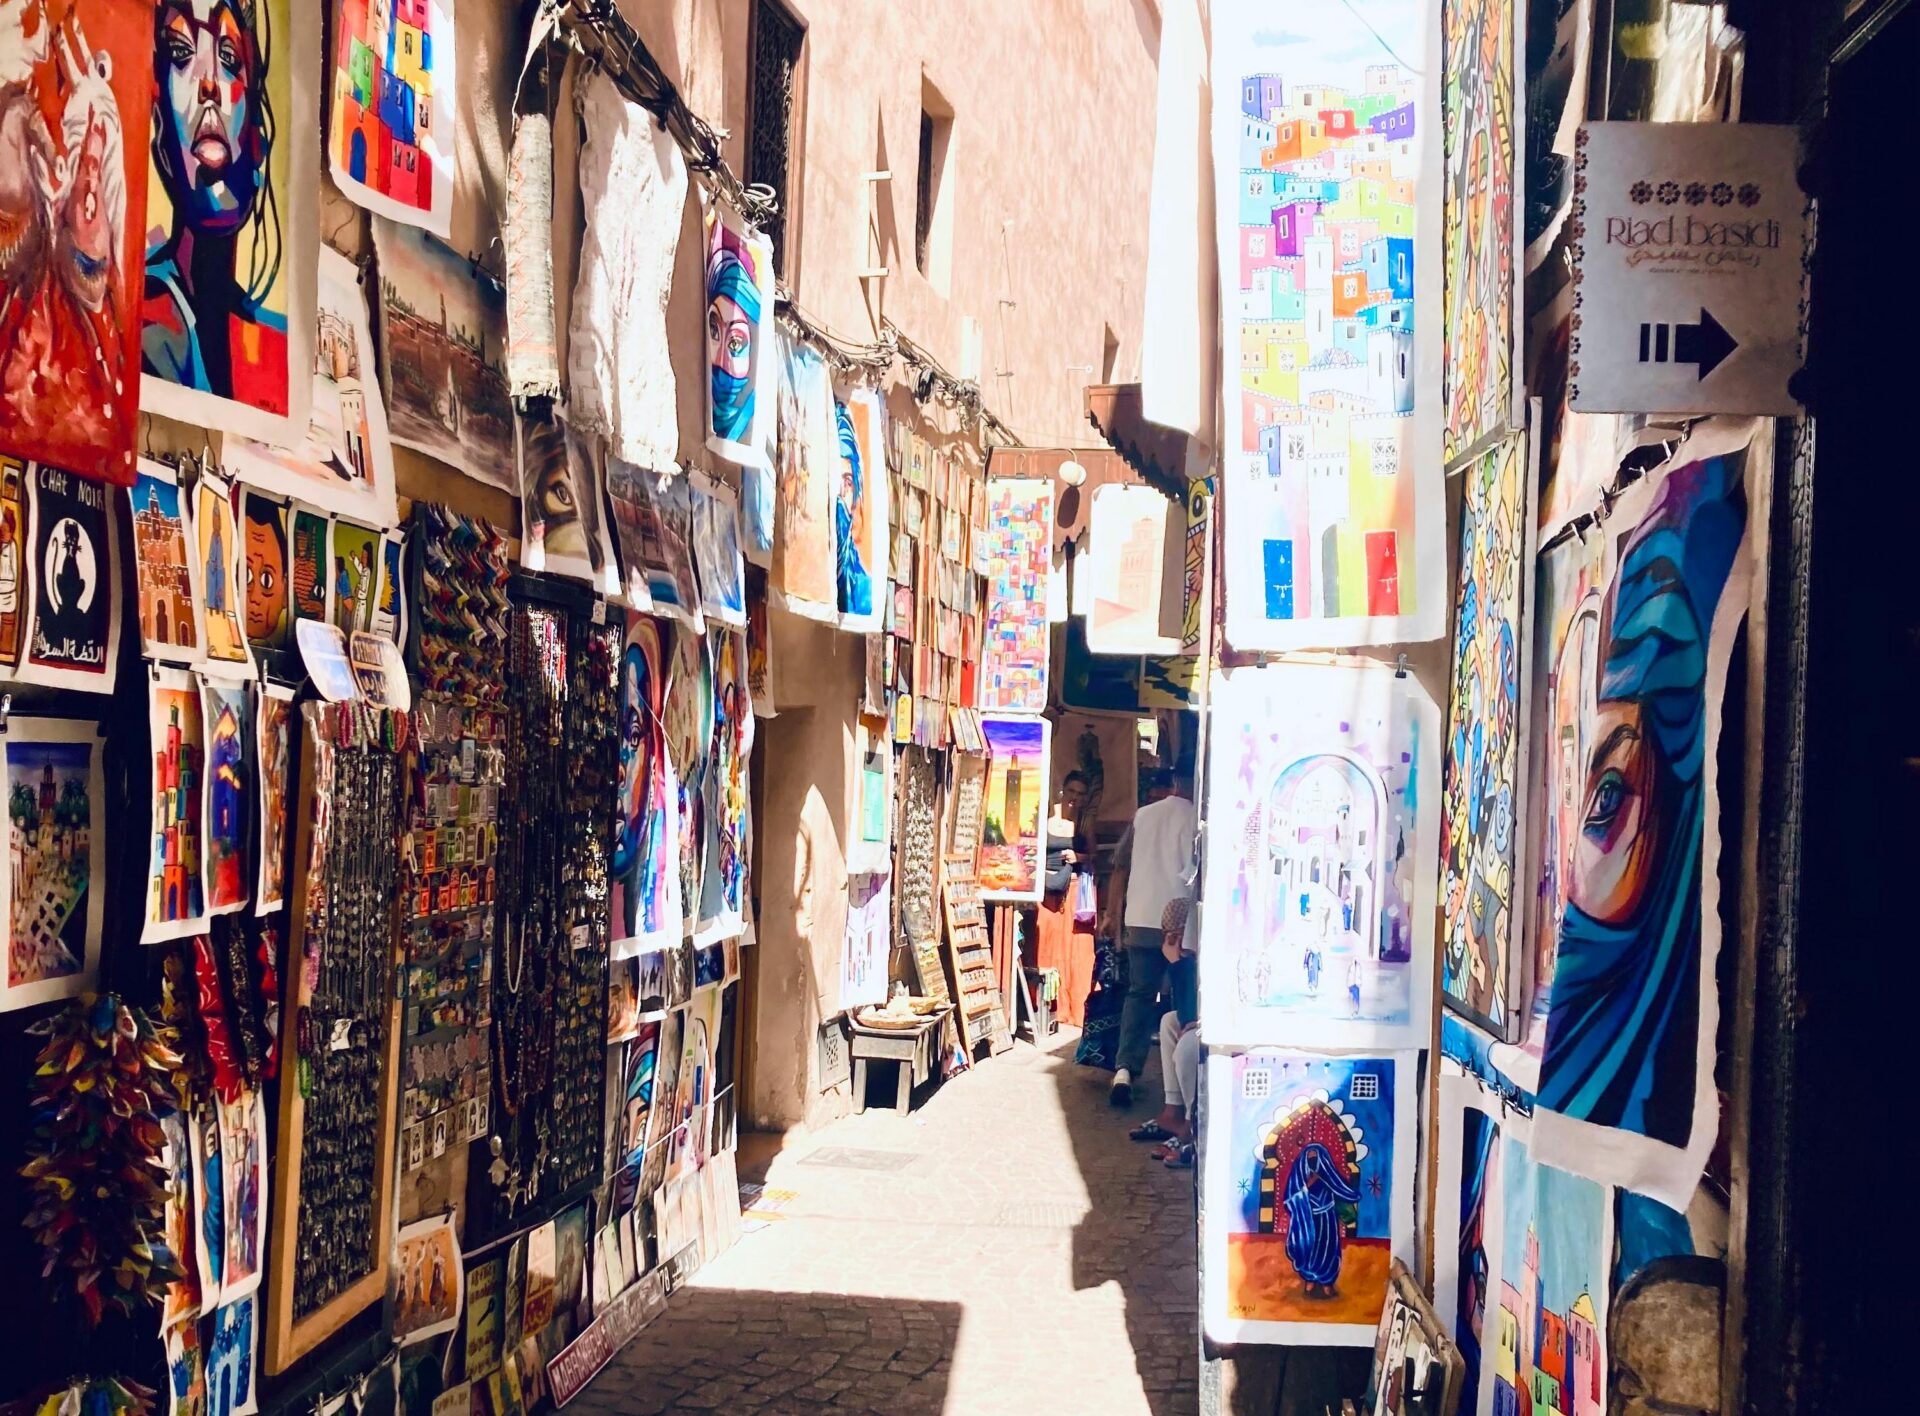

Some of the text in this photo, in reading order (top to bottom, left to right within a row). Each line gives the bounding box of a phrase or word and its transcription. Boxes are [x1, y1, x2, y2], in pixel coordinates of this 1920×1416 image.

[1606, 214, 1781, 249] Riad basidi
[78, 480, 104, 513] NOIR
[550, 1326, 607, 1401] MARRAKECH
